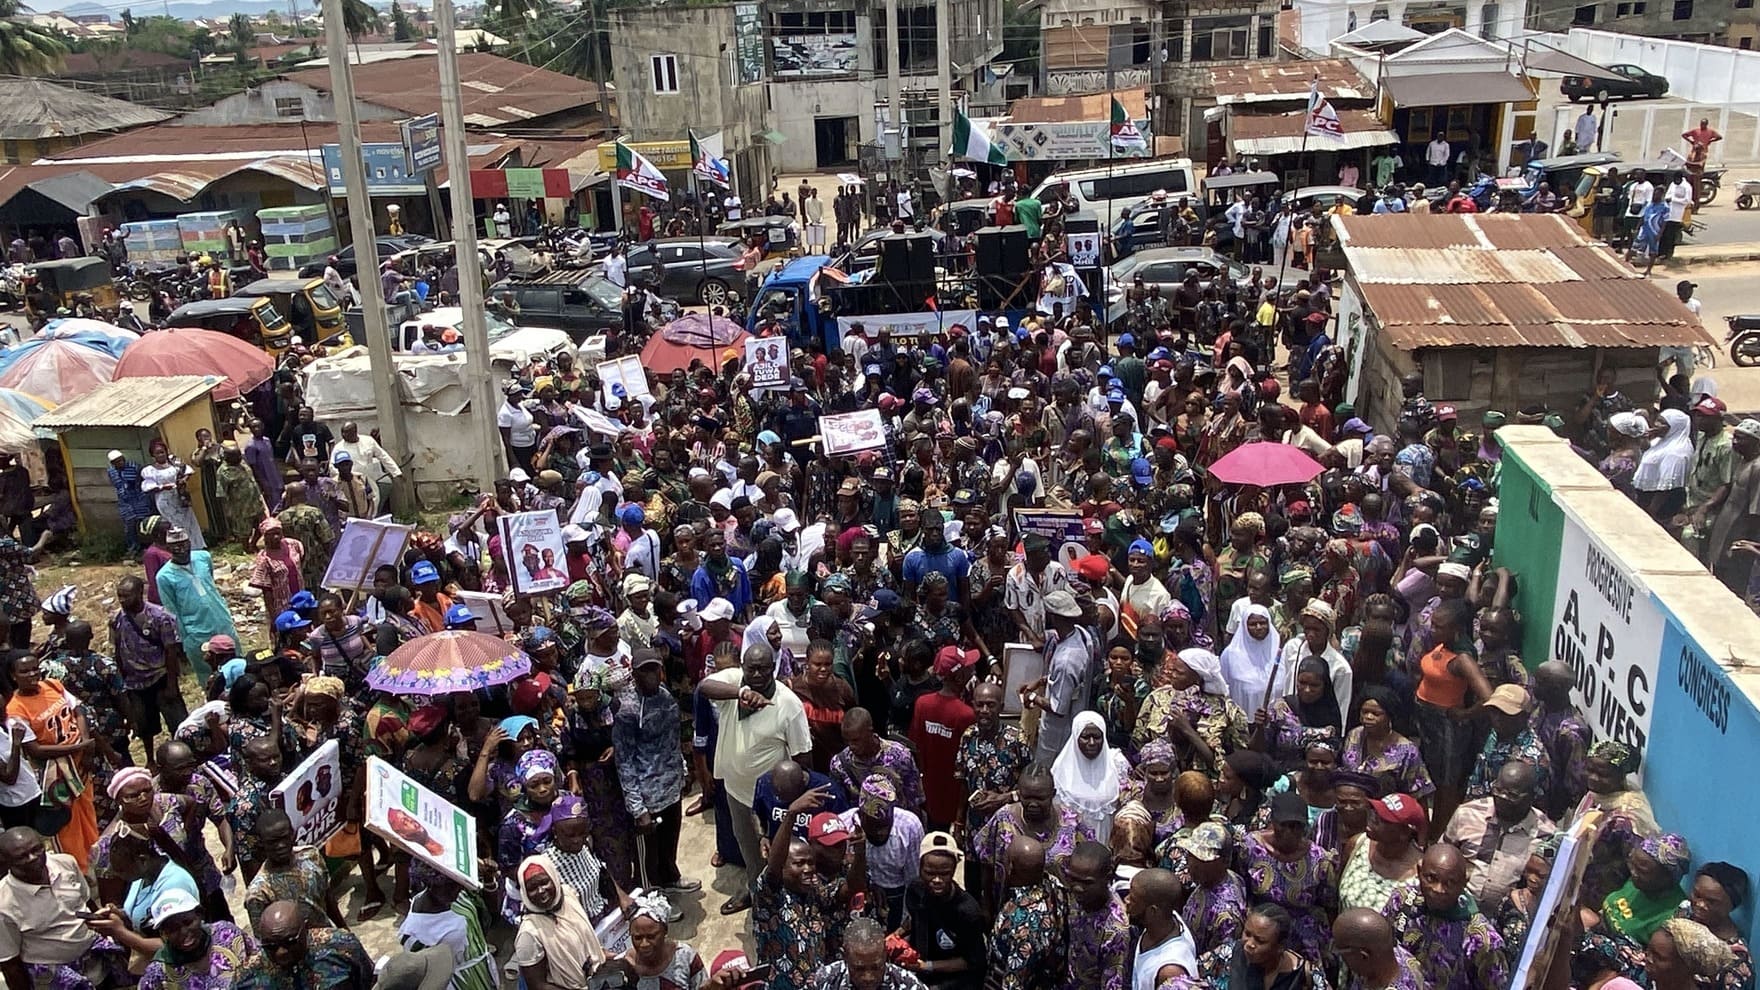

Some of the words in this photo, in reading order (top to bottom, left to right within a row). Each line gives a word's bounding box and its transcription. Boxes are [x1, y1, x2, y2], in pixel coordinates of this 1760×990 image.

[625, 172, 659, 189] APC
[909, 335, 939, 345] TUA
[753, 361, 780, 372] AJILO
[754, 367, 781, 376] TUWA
[754, 373, 780, 382] DEDE
[1585, 543, 1635, 625] PROGRESSIVE
[1555, 624, 1597, 708] ONDO
[1600, 682, 1646, 755] WEST
[1627, 664, 1649, 718] C
[1678, 646, 1731, 736] CONGRESS
[296, 797, 338, 842] AJILO
